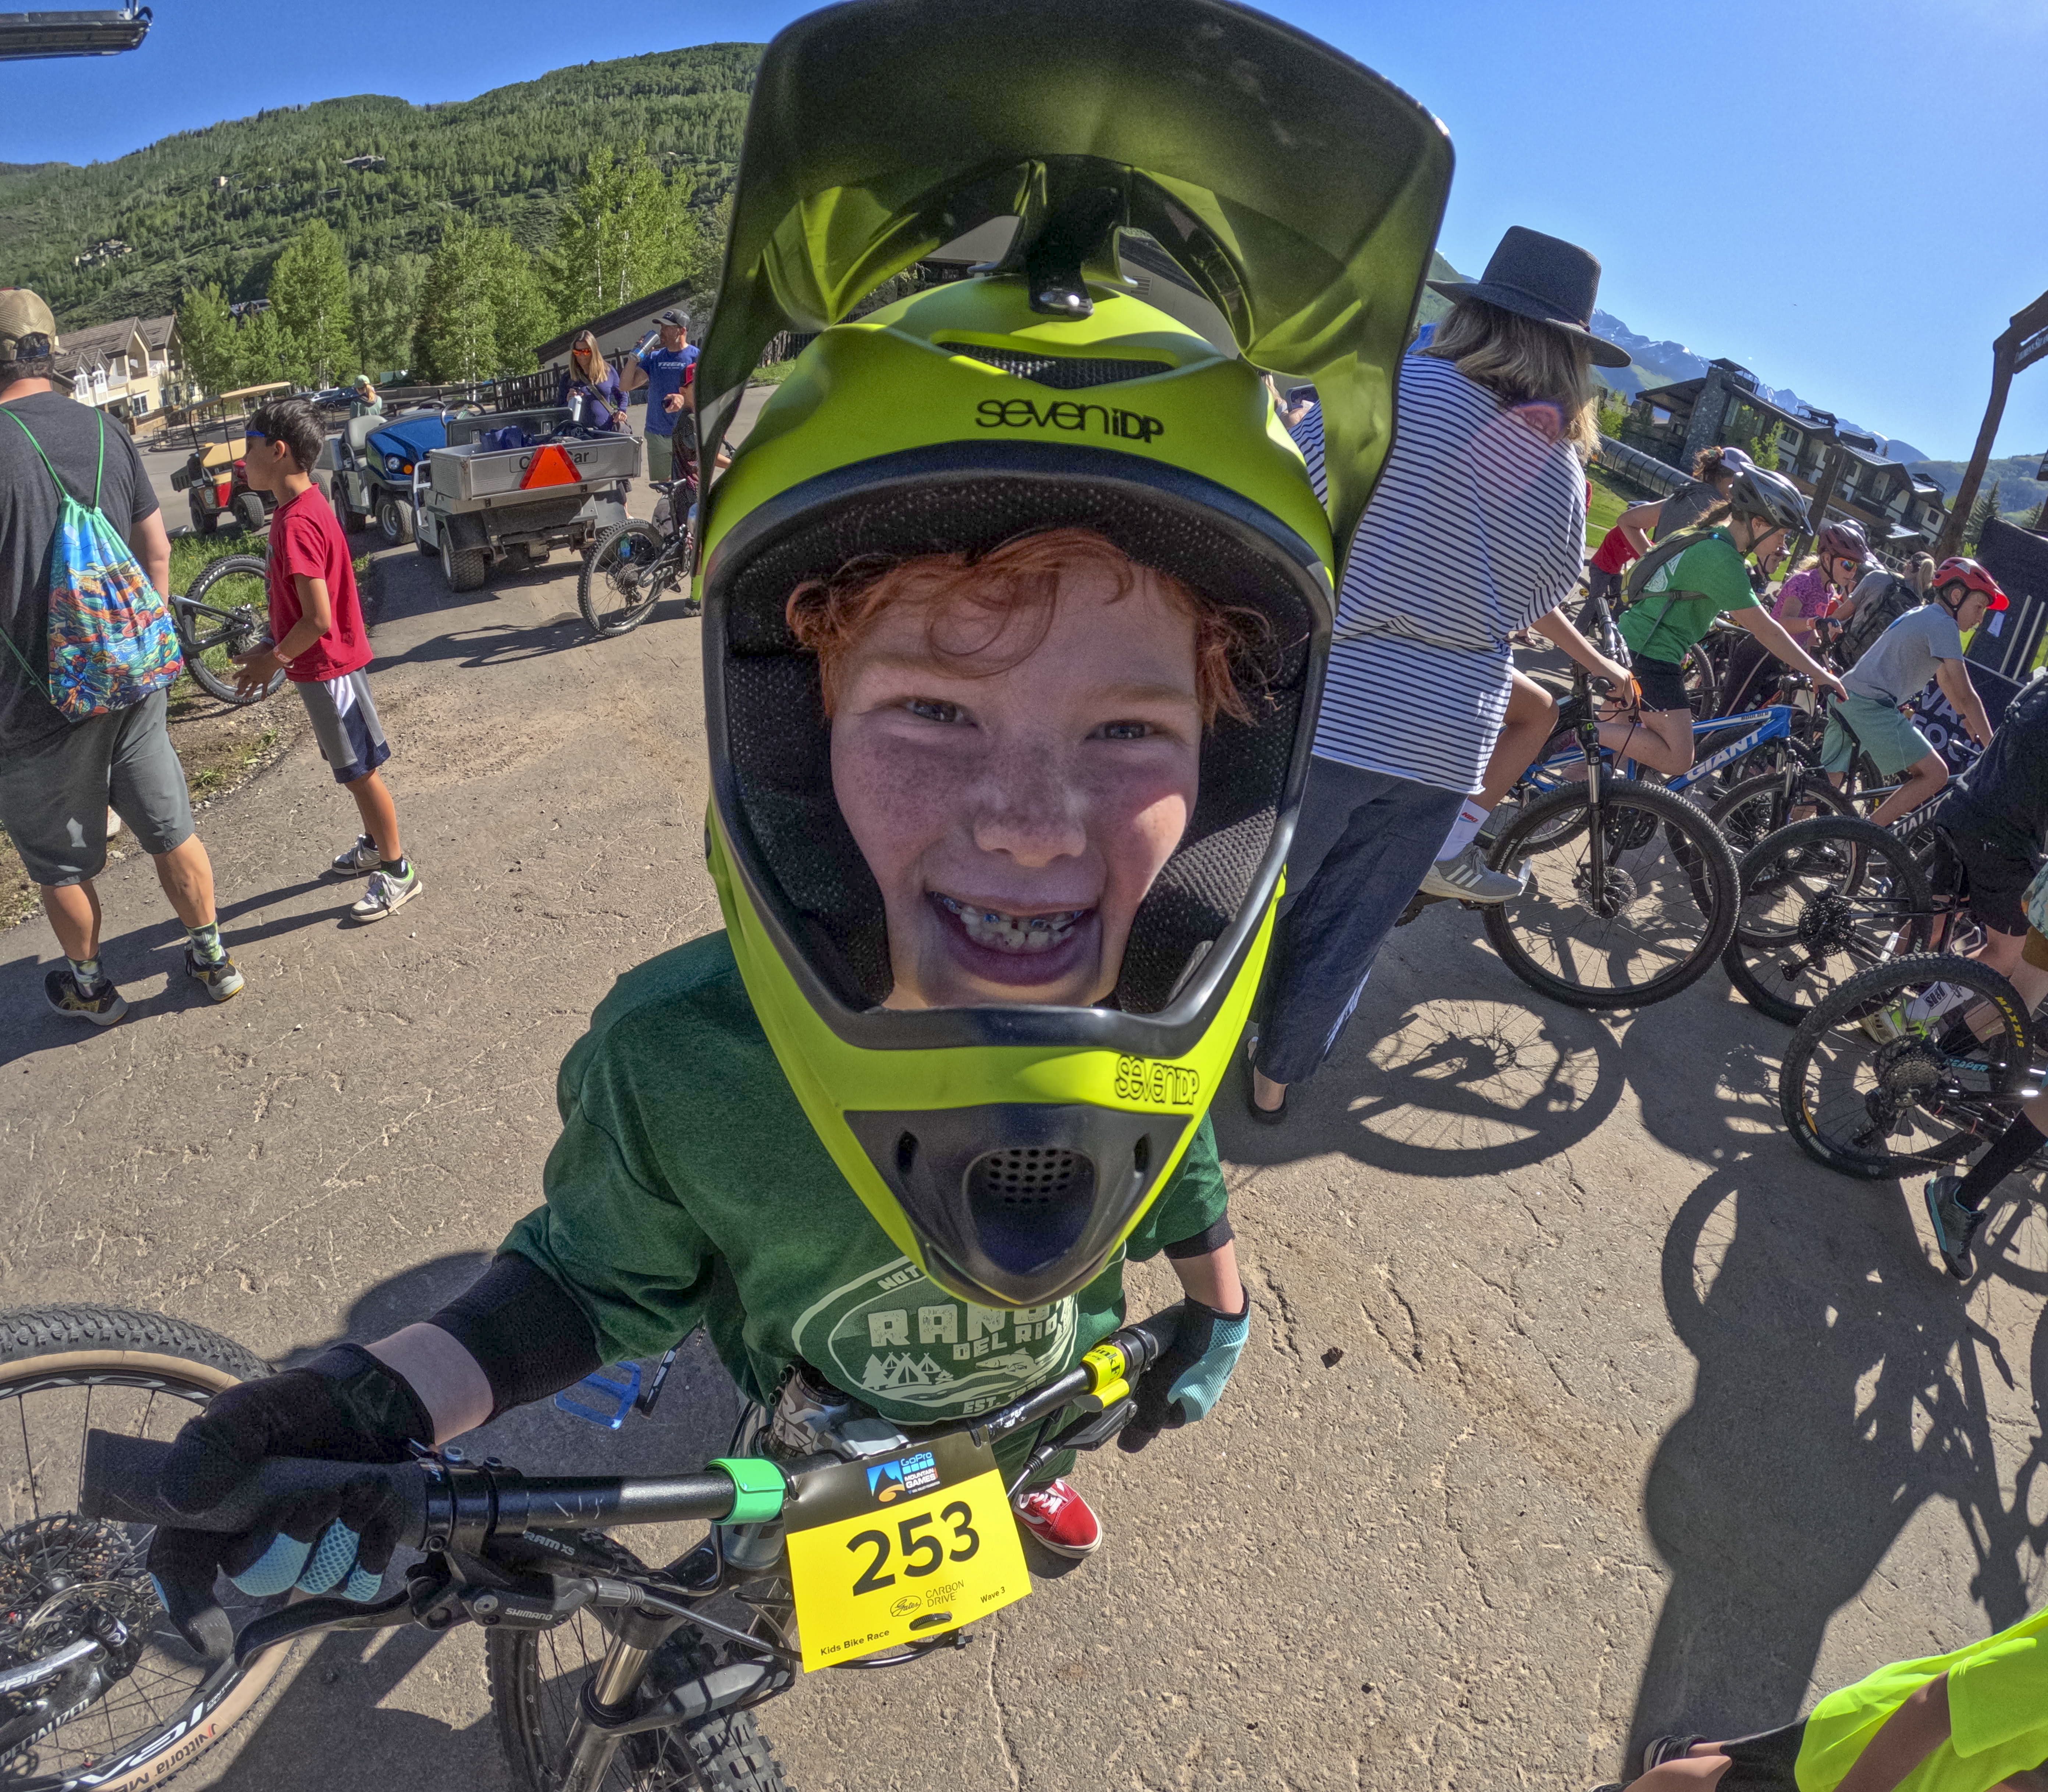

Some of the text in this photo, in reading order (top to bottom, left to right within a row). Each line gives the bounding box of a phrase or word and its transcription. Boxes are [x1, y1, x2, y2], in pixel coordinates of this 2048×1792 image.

[200, 566, 225, 592] MAXXIS
[1685, 728, 1762, 781] GIANT
[1461, 812, 1479, 823] NIKE
[1498, 844, 1515, 869] RANGER
[1995, 996, 2024, 1047] MAXXIS
[953, 1312, 1057, 1361] DEL RIO
[963, 1397, 1000, 1414] EST.
[901, 1452, 932, 1466] GoPro
[904, 1468, 934, 1482] MOUNTAIN
[906, 1473, 936, 1489] GAMES
[846, 1501, 979, 1596] 253
[925, 1579, 964, 1599] CARBON
[927, 1593, 956, 1607] DRIVE
[980, 1591, 999, 1604] Wave
[505, 1608, 552, 1620] SHIMANO
[892, 1598, 920, 1616] Gates
[820, 1629, 890, 1656] Kids Bike Race
[0, 1667, 53, 1692] PIC
[207, 1671, 239, 1707] CONTROL
[156, 1733, 209, 1775] vittoria
